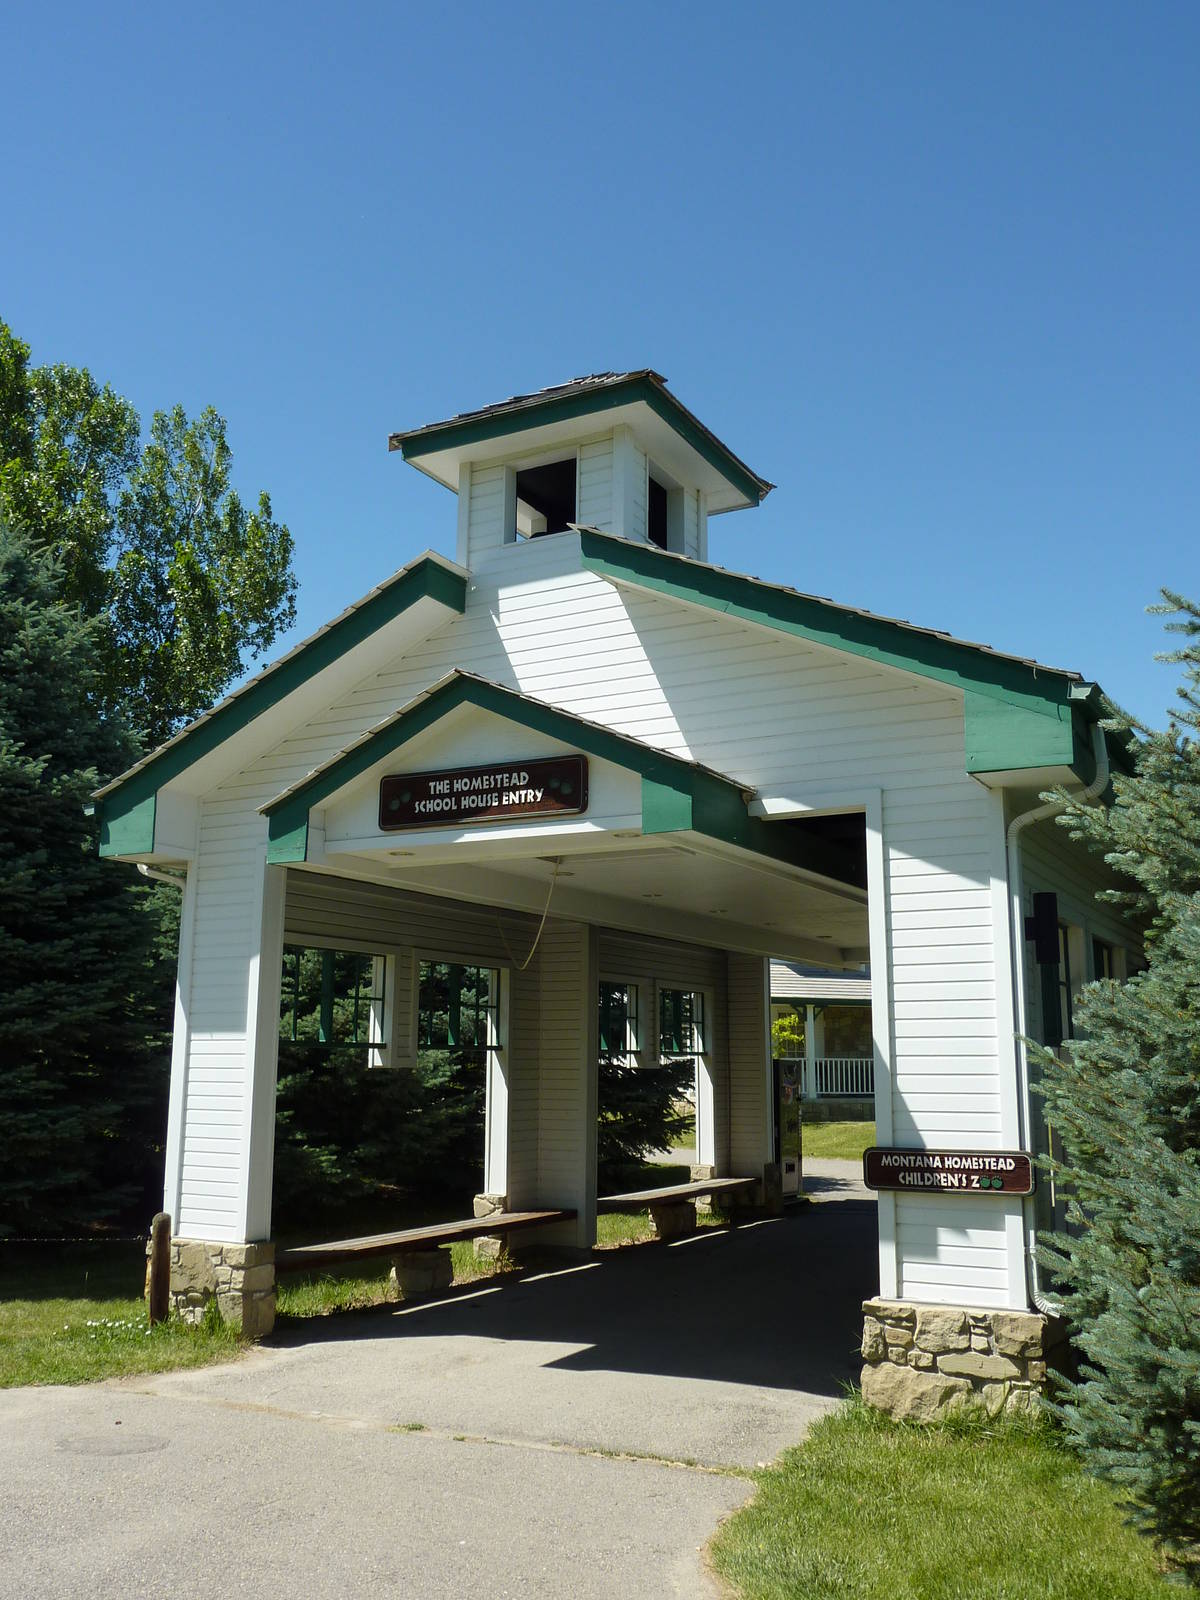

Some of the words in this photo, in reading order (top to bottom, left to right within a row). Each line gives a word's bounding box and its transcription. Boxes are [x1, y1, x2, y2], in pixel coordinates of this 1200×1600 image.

[429, 779, 450, 795] THE
[453, 772, 529, 792] HOMESTEAD
[414, 797, 457, 814] SCHOOL
[461, 793, 499, 809] HOUSE
[502, 788, 544, 805] ENTRY
[881, 1154, 942, 1168] MONTANA
[944, 1156, 1016, 1171] HOMESTEAD
[898, 1171, 967, 1187] CHILDREN'S
